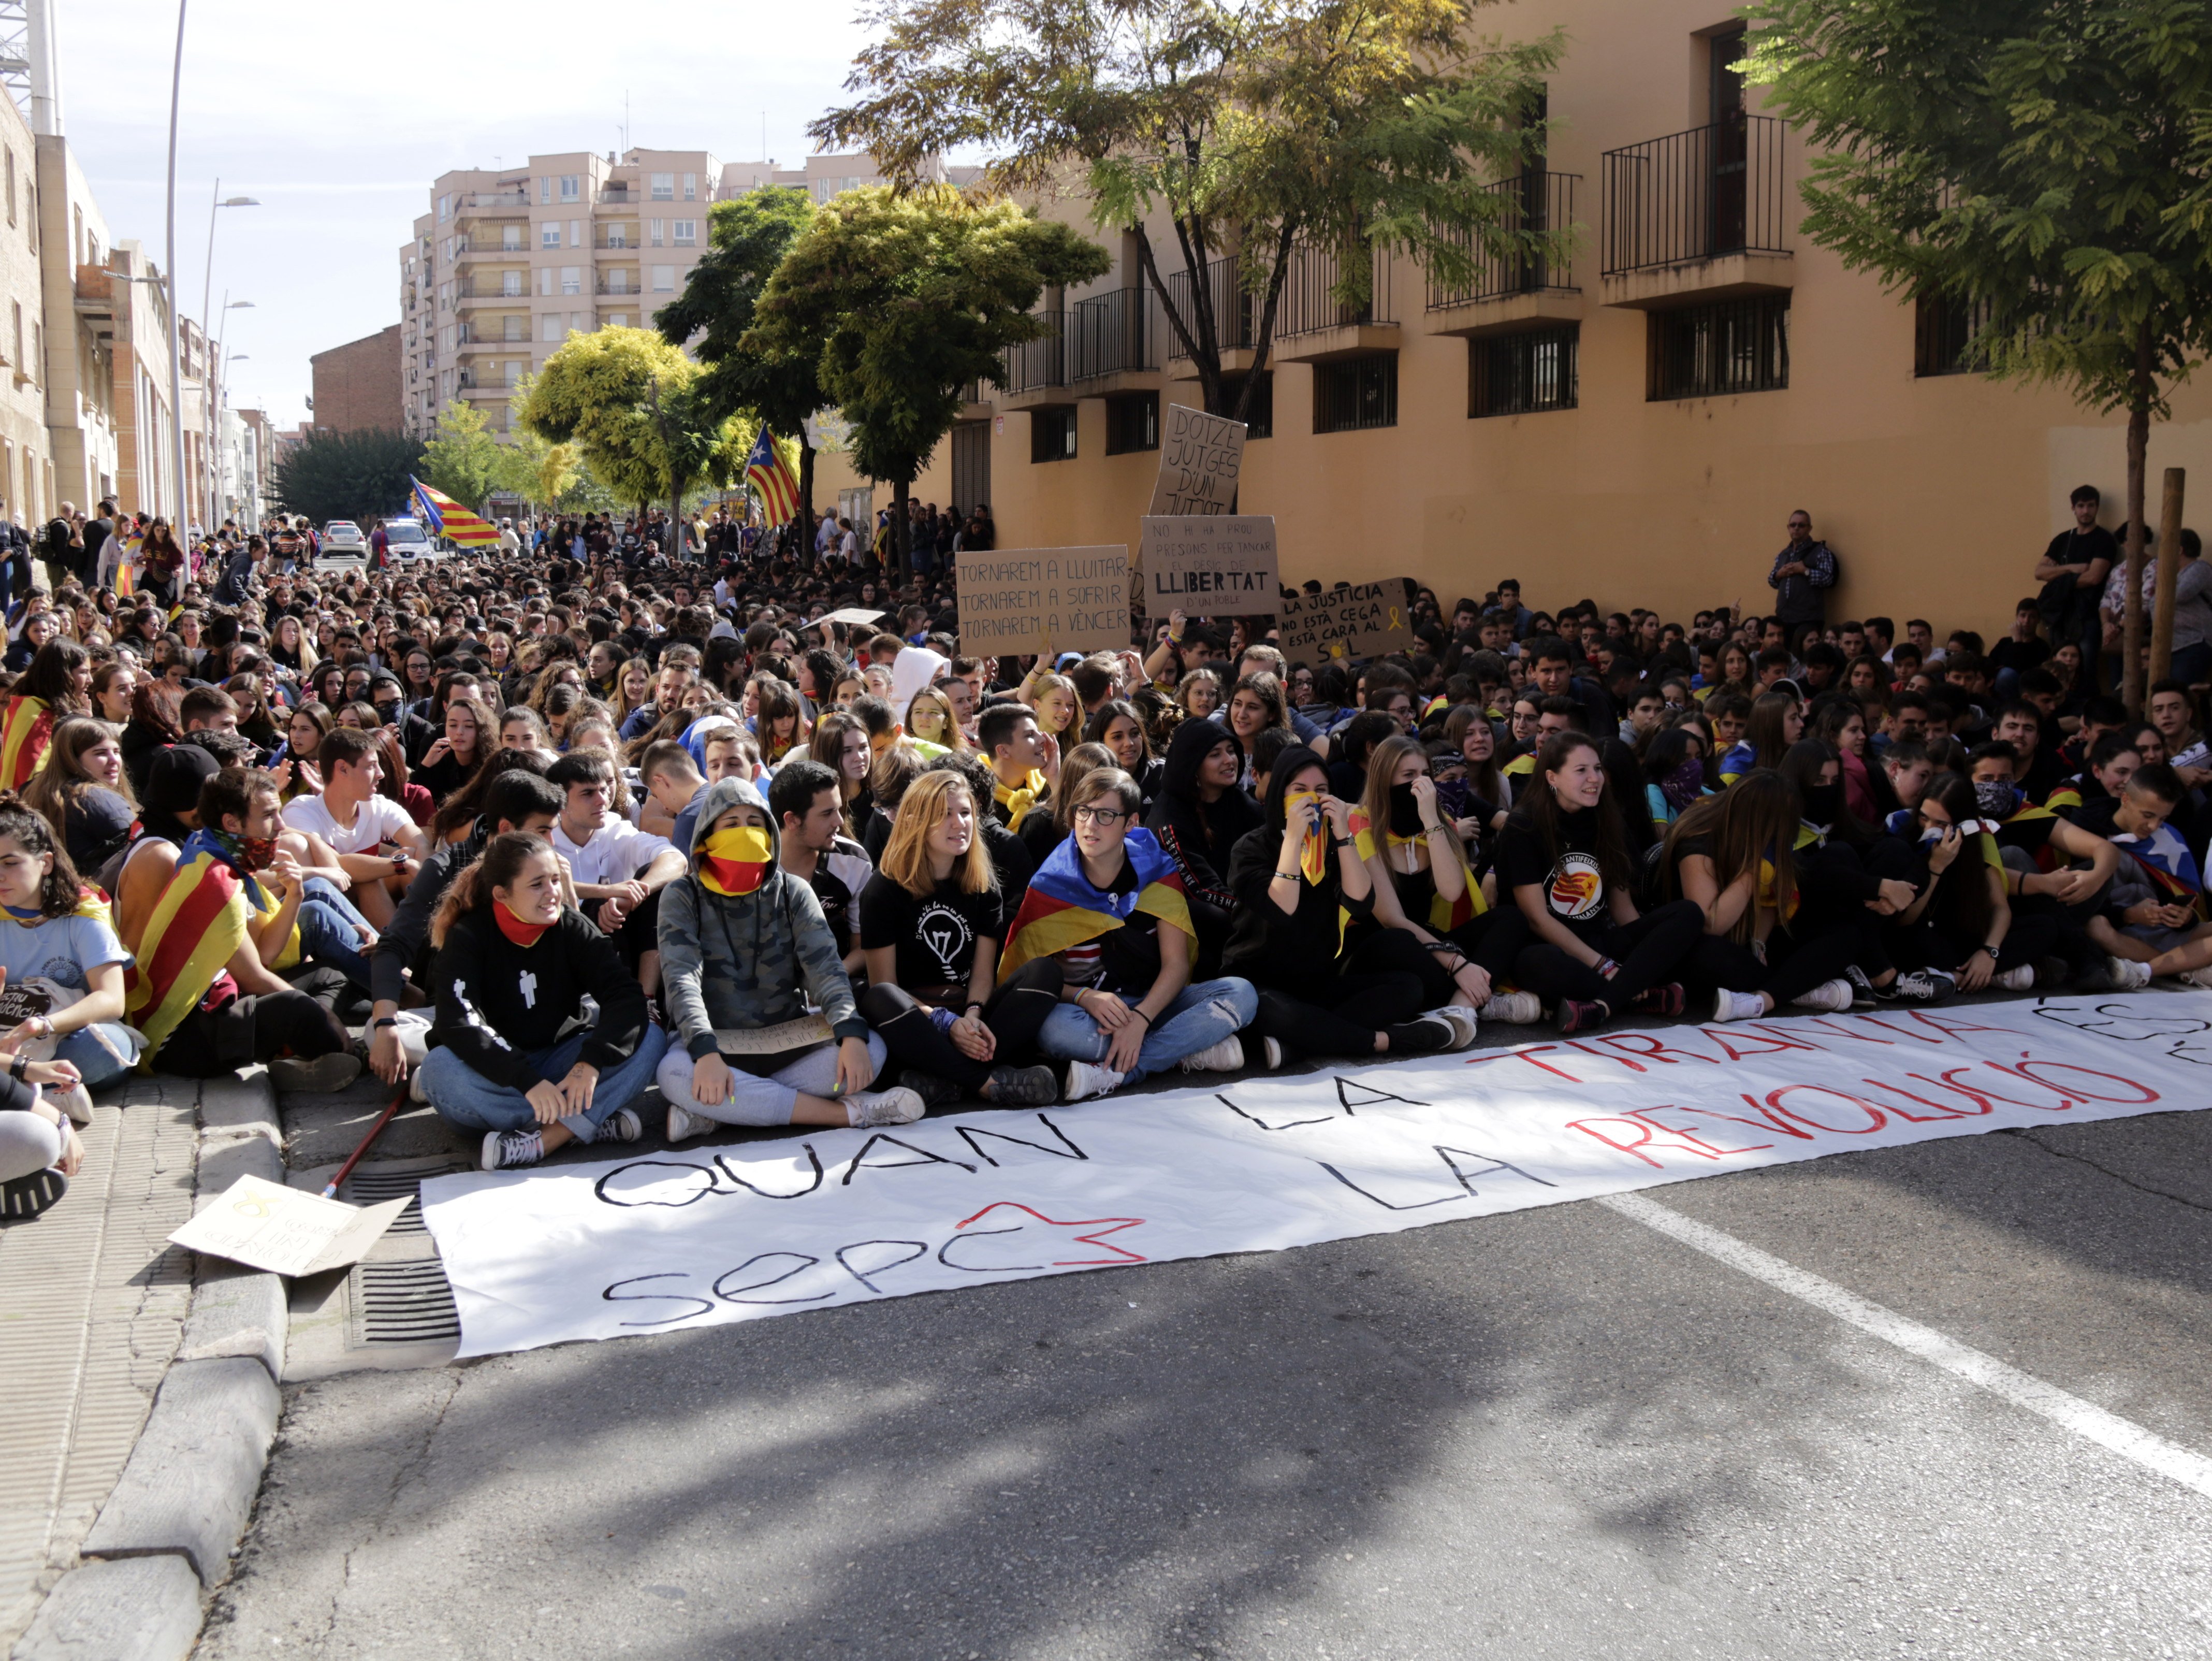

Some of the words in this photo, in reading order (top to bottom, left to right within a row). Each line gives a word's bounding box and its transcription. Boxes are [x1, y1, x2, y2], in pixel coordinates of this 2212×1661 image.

[1174, 411, 1241, 451] DOTZE
[1169, 439, 1239, 478] JUTGES
[1177, 468, 1216, 498] D'UN
[1153, 524, 1170, 538] NO
[1185, 525, 1193, 536] HI
[1203, 525, 1214, 535] HA
[1227, 524, 1252, 535] PROU
[1156, 543, 1208, 557] PRESONS
[1217, 544, 1233, 554] PER
[1238, 542, 1271, 553] TANCAR
[959, 561, 1041, 582] TORNAREM
[1047, 559, 1058, 580] A
[1067, 557, 1126, 580] LLUITAR
[1172, 561, 1183, 571] EL
[1194, 560, 1221, 571] DESIG
[1231, 560, 1246, 571] DE
[1156, 572, 1268, 595] LLIBERTAT
[961, 590, 1040, 612] TORNAREM
[1049, 588, 1058, 606] A
[1067, 585, 1121, 605] SOFRIR
[1187, 597, 1211, 608] D'UN
[1215, 596, 1241, 607] POBLE
[1284, 601, 1302, 615] LA
[963, 614, 1041, 639] TORNAREM
[1049, 614, 1059, 632] A
[1068, 609, 1127, 631] VÈNCER
[1282, 620, 1297, 632] NO
[1304, 610, 1332, 629] ESTÀ
[1340, 603, 1381, 621] CEGA
[1289, 629, 1317, 647] ESTÀ
[1322, 623, 1357, 640] CARA
[1364, 620, 1380, 633] AL
[42, 958, 56, 970] PENYA
[594, 1113, 1089, 1207] QUAN
[1214, 1076, 1433, 1131] LA
[1465, 1010, 2036, 1084] TIRANIA
[2032, 998, 2211, 1040] ÉS
[1305, 1145, 1559, 1211] LA
[1564, 1051, 2161, 1169] REVOLUCIÓ
